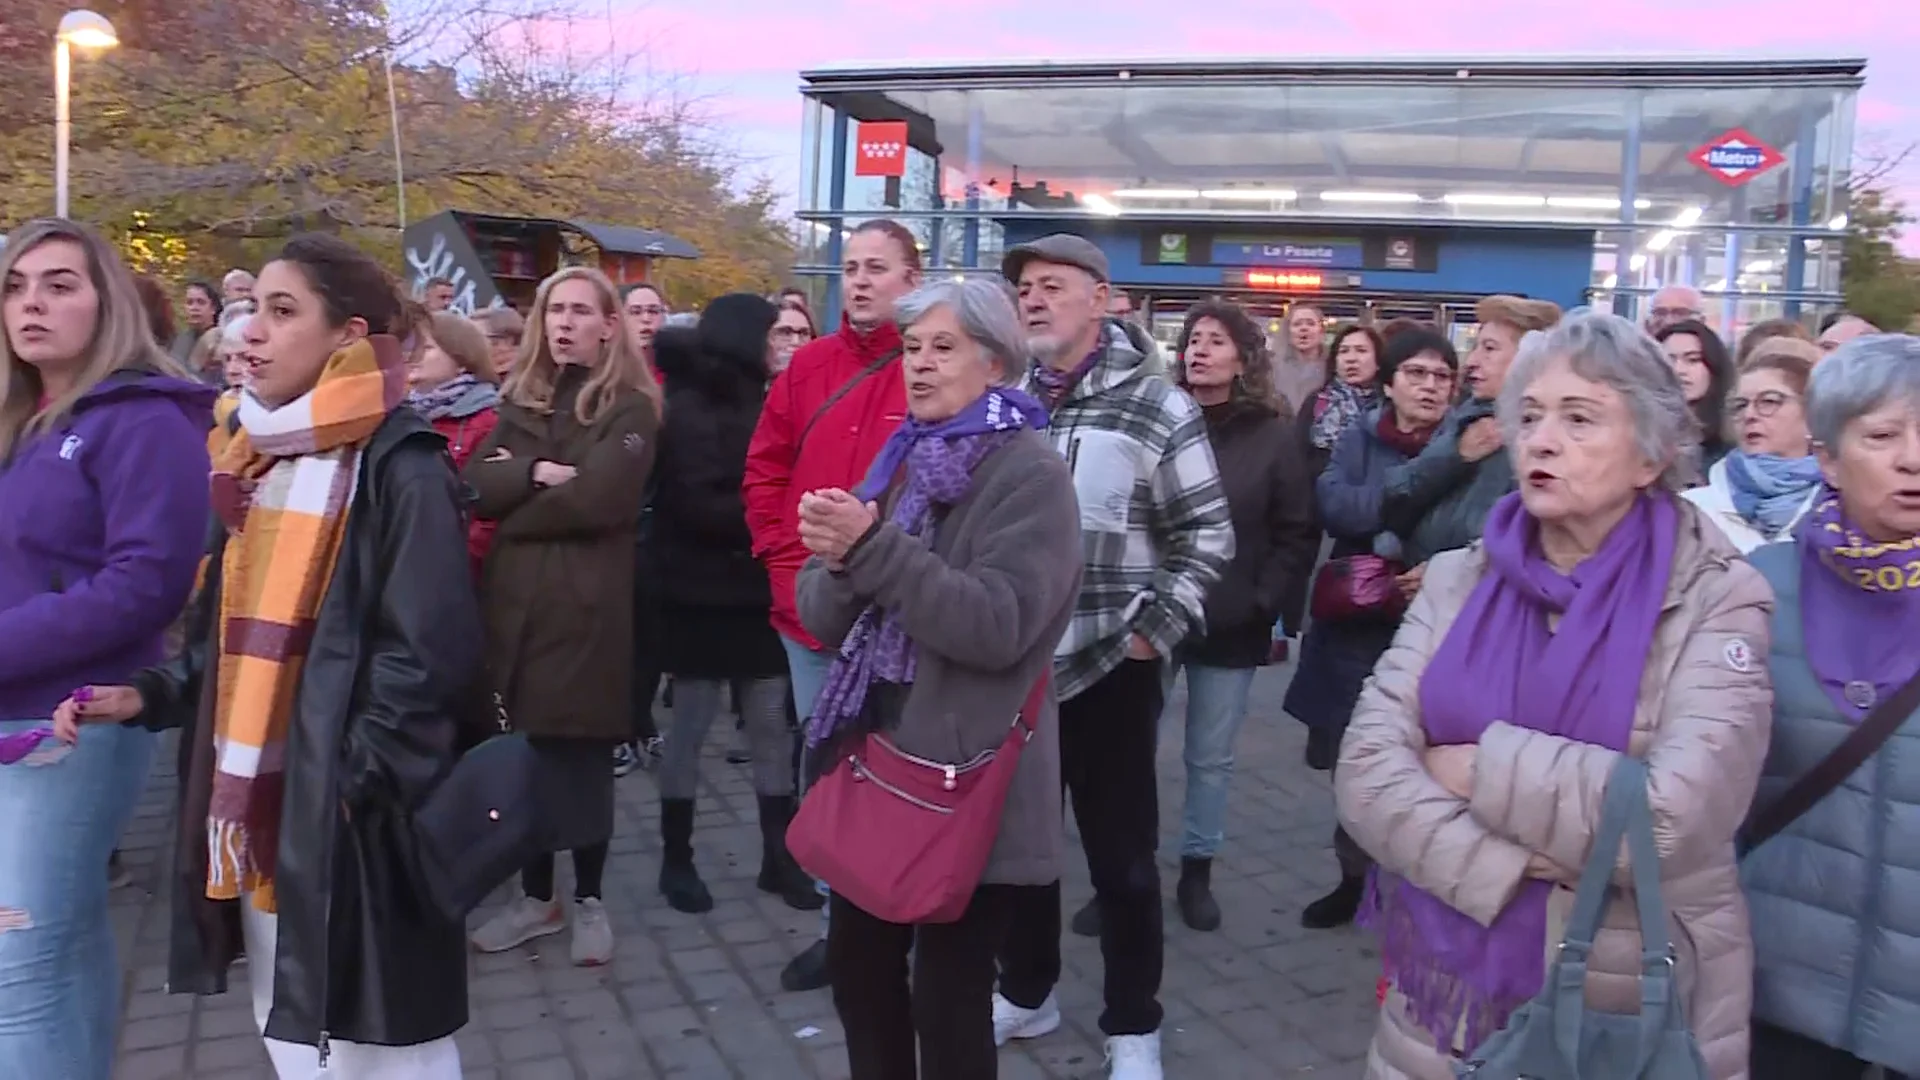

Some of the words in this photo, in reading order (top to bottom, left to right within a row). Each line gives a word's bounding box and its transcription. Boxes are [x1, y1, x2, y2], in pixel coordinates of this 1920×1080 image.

[1710, 150, 1757, 165] Metro
[1263, 245, 1281, 256] La
[1284, 245, 1333, 257] Peseta
